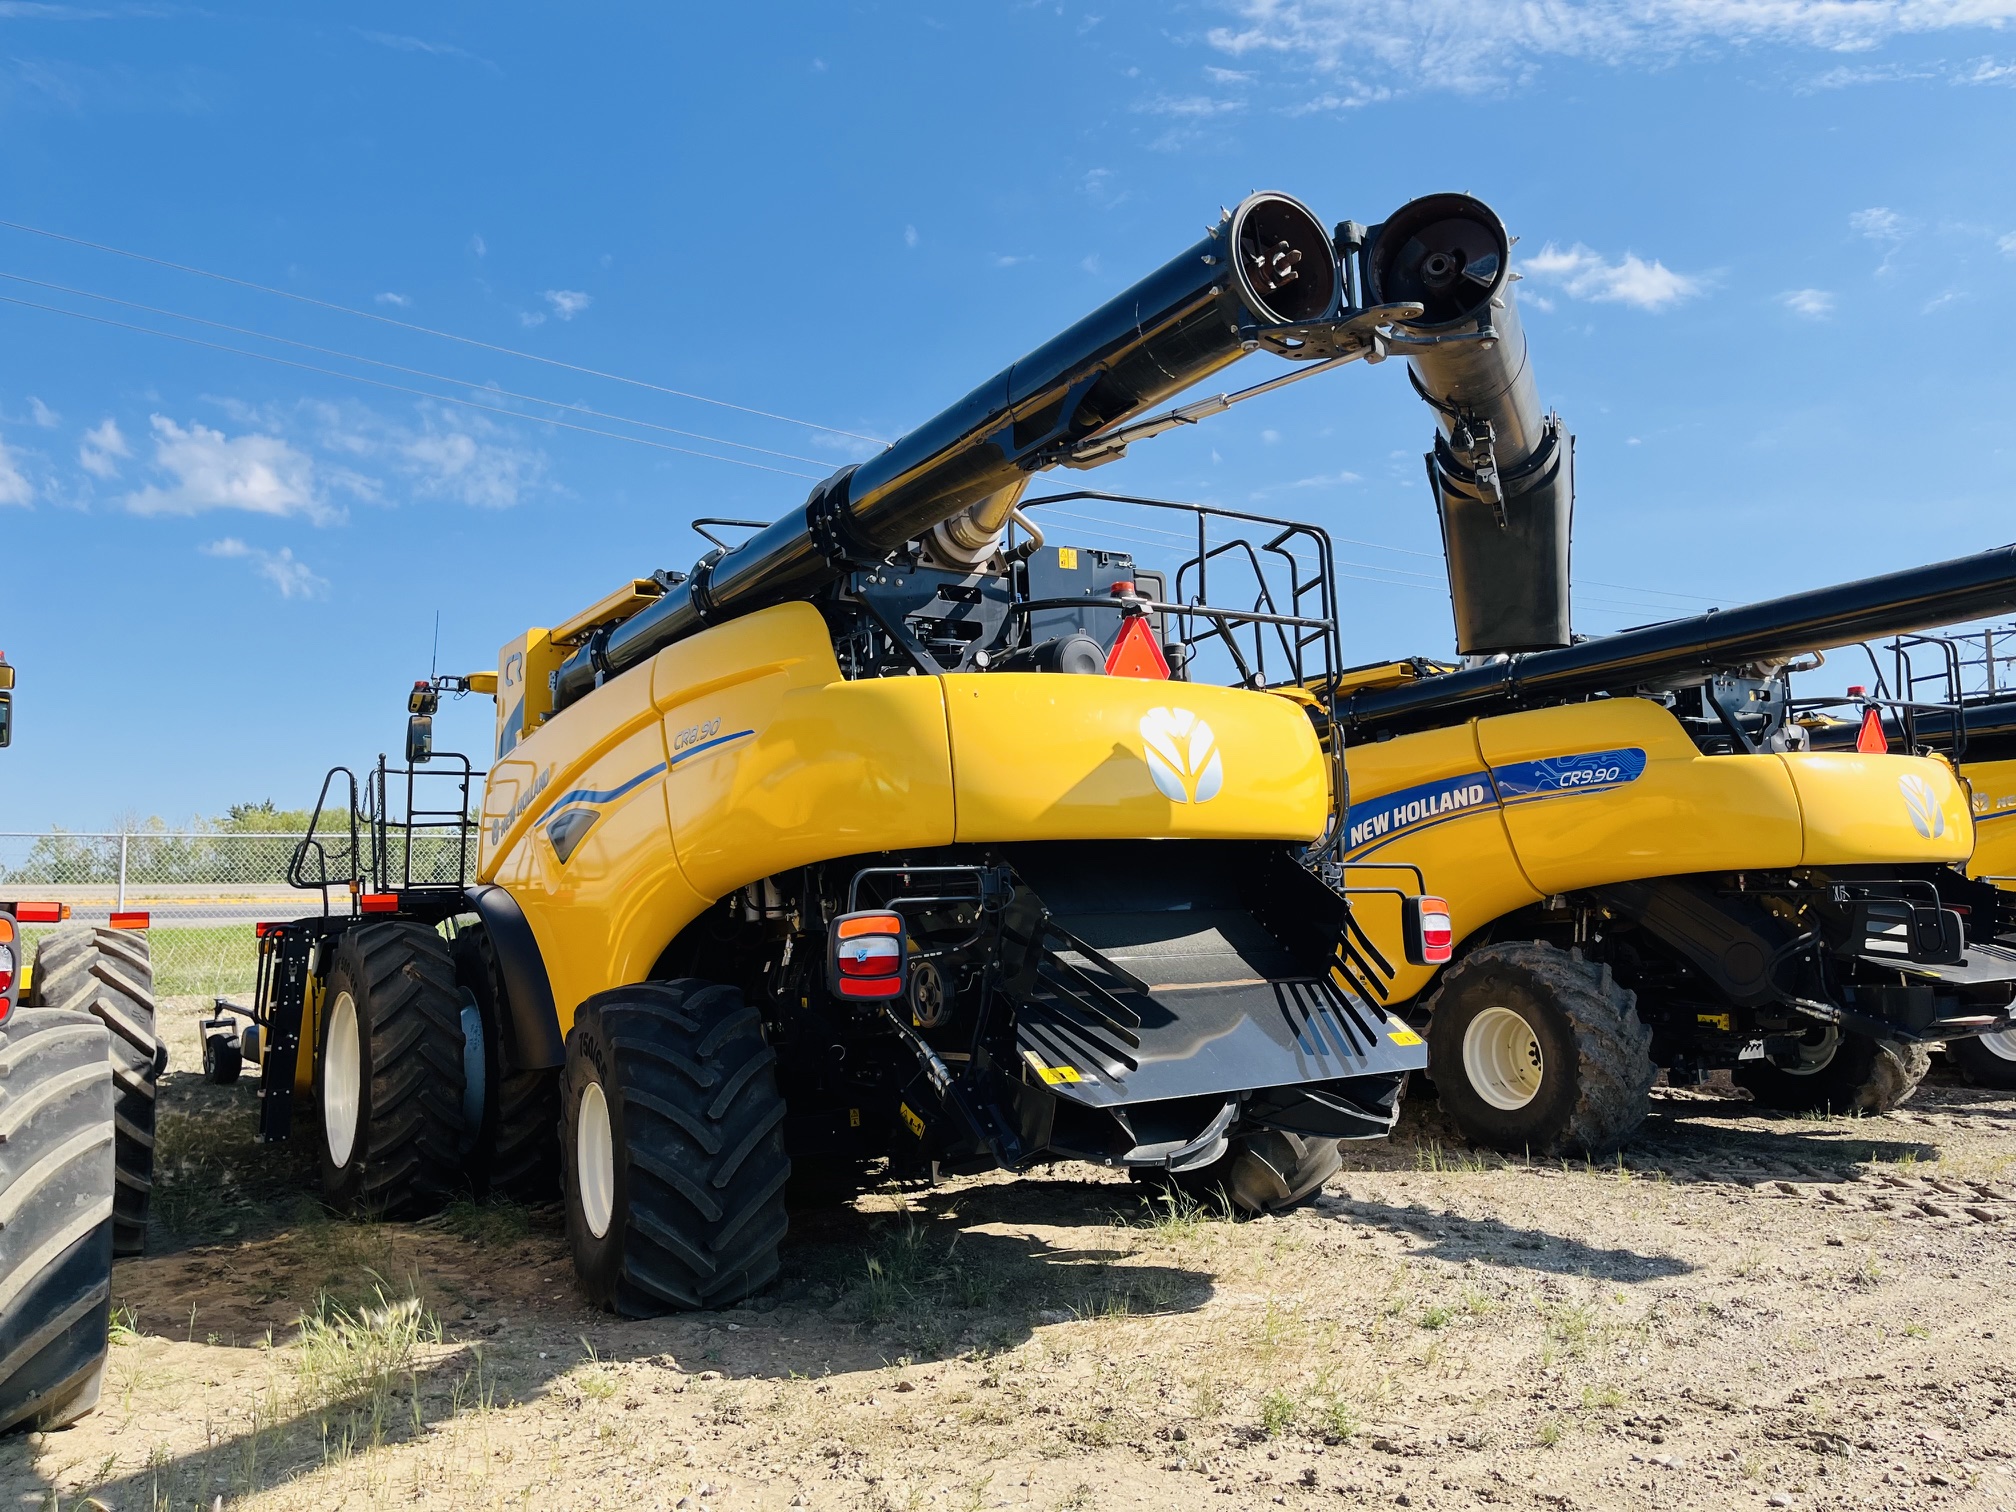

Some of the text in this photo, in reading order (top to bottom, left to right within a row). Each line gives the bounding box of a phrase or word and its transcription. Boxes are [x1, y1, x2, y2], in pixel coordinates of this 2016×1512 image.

[505, 651, 522, 687] CR
[674, 716, 721, 750] CR8.90
[1559, 766, 1620, 787] CR9.90
[501, 767, 550, 838] NEW HOLLAND
[1350, 784, 1485, 848] NEW HOLLAND
